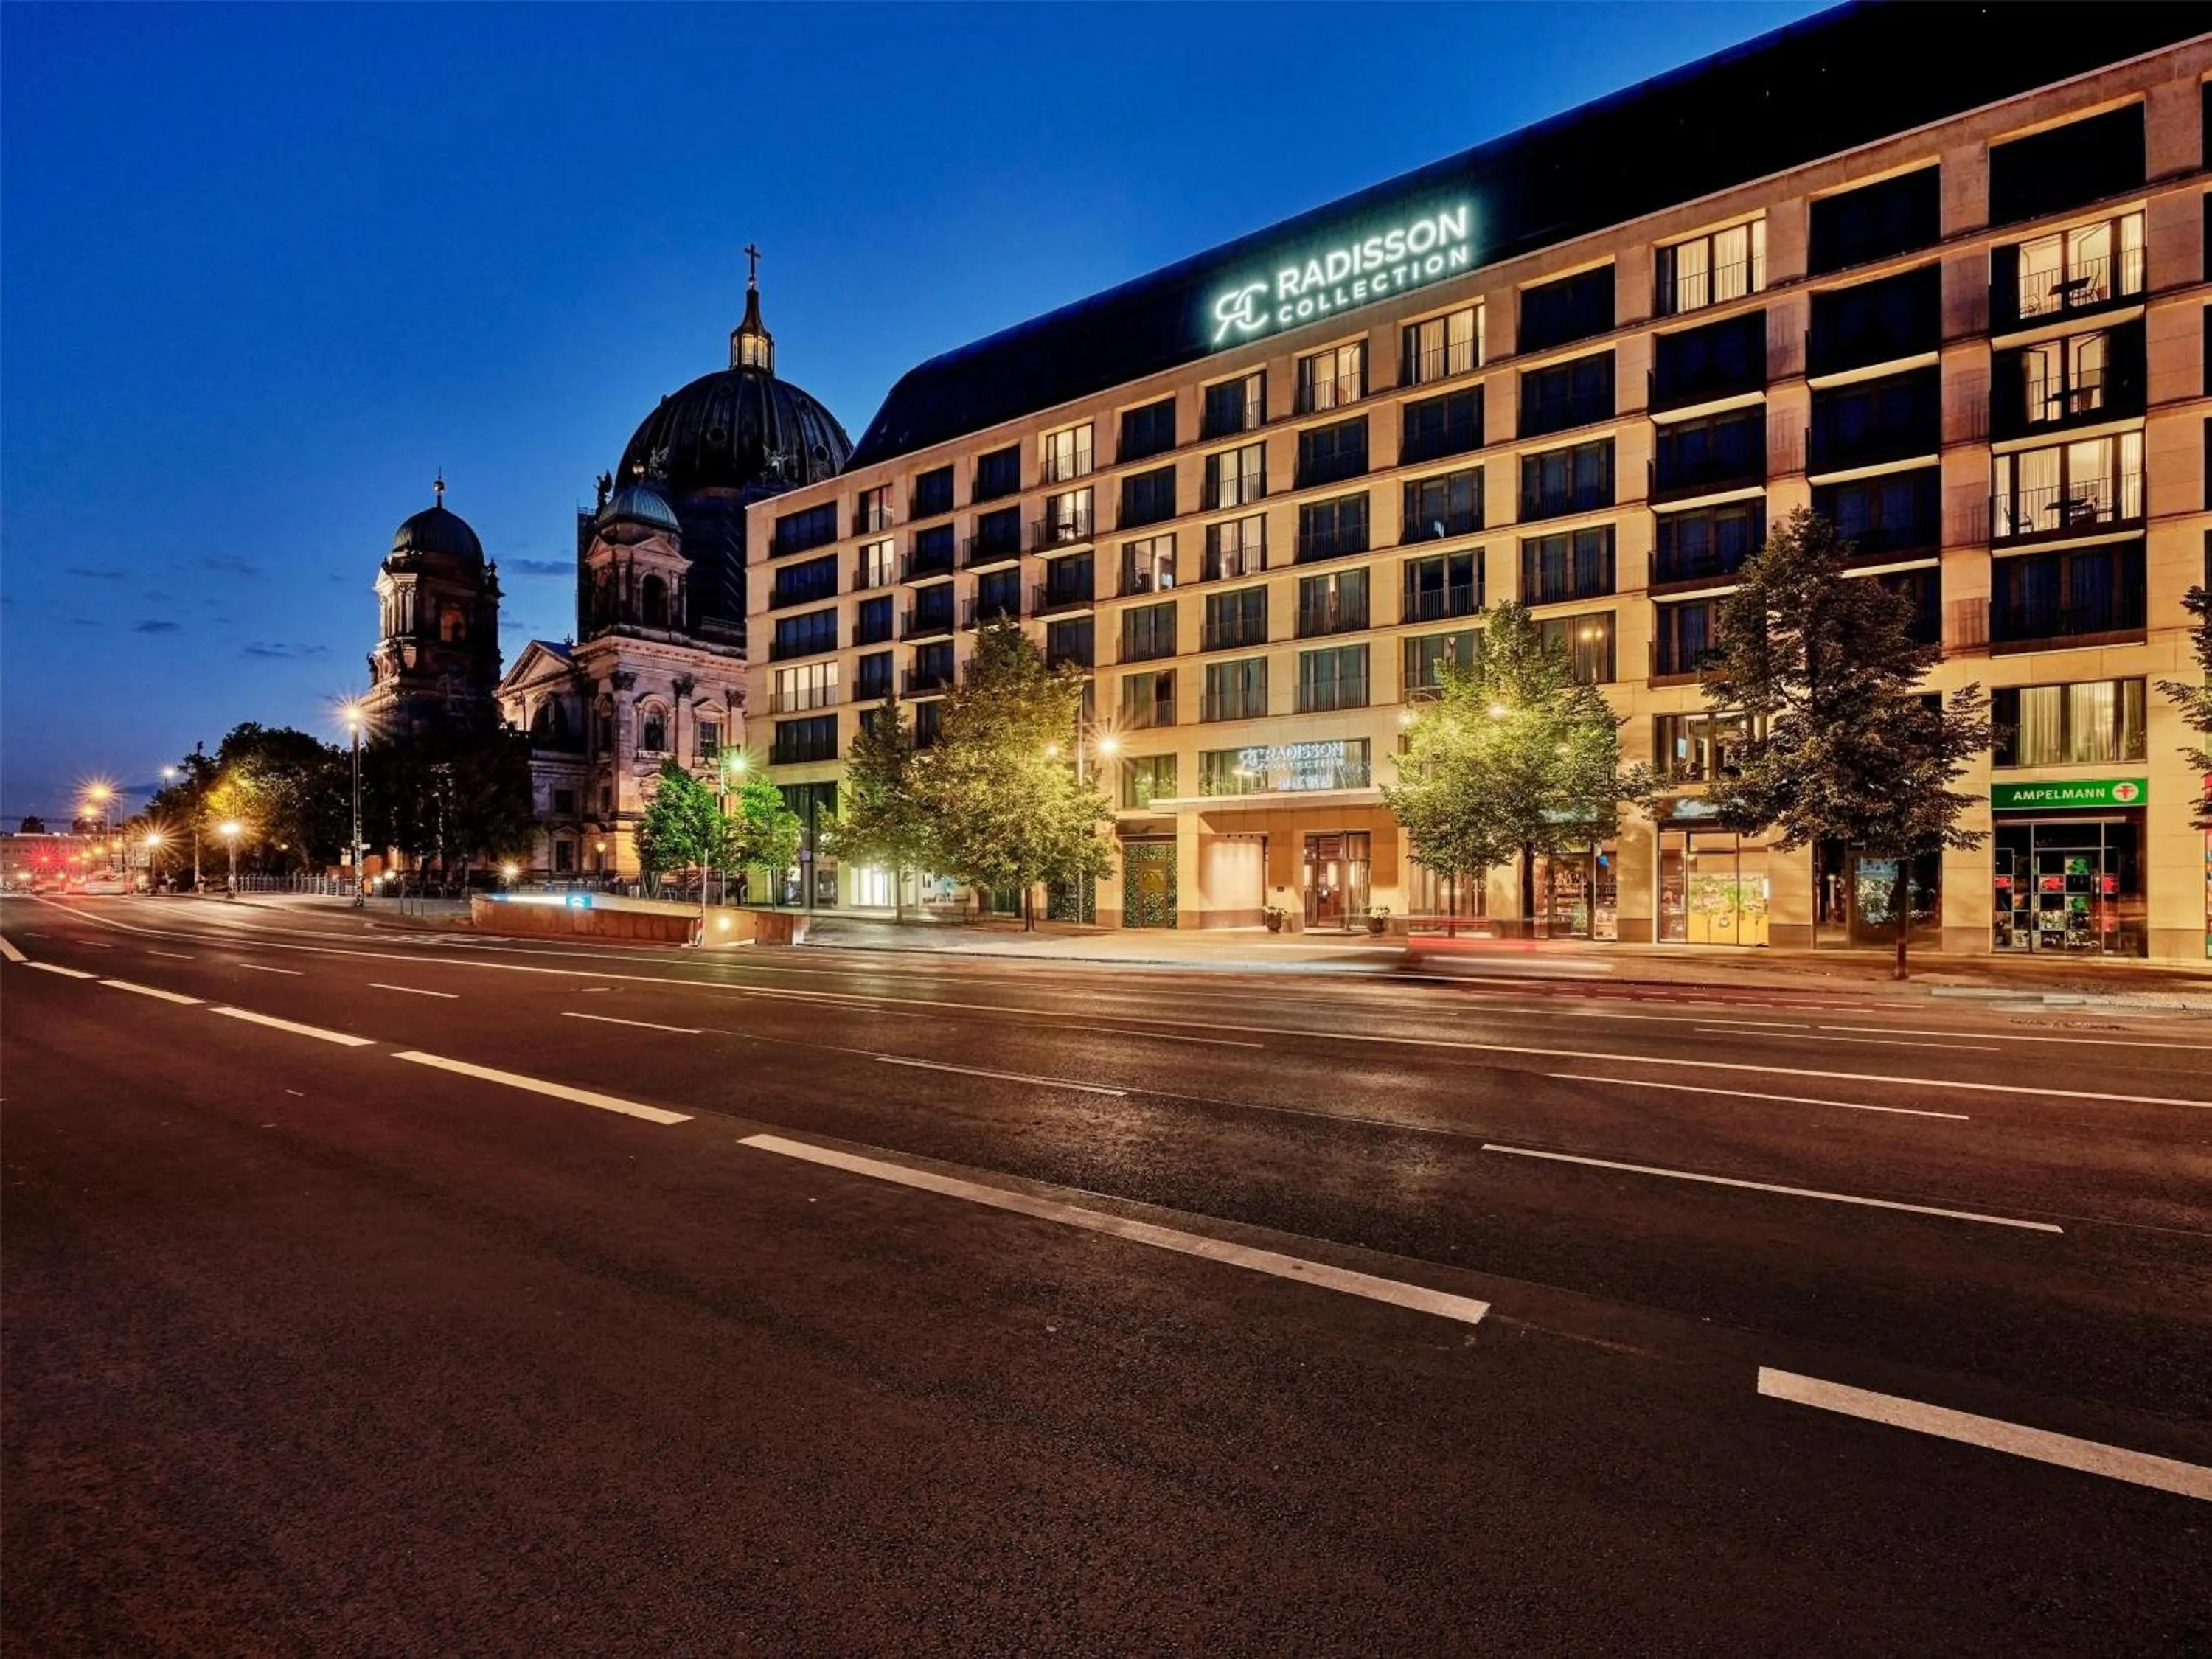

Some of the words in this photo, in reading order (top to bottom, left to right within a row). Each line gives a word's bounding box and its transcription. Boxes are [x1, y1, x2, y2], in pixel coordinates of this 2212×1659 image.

[1278, 206, 1467, 301] RADISSON
[1278, 246, 1468, 322] COLLECTION
[1266, 742, 1343, 760] RADISSON
[2013, 788, 2106, 801] AMPELMANN
